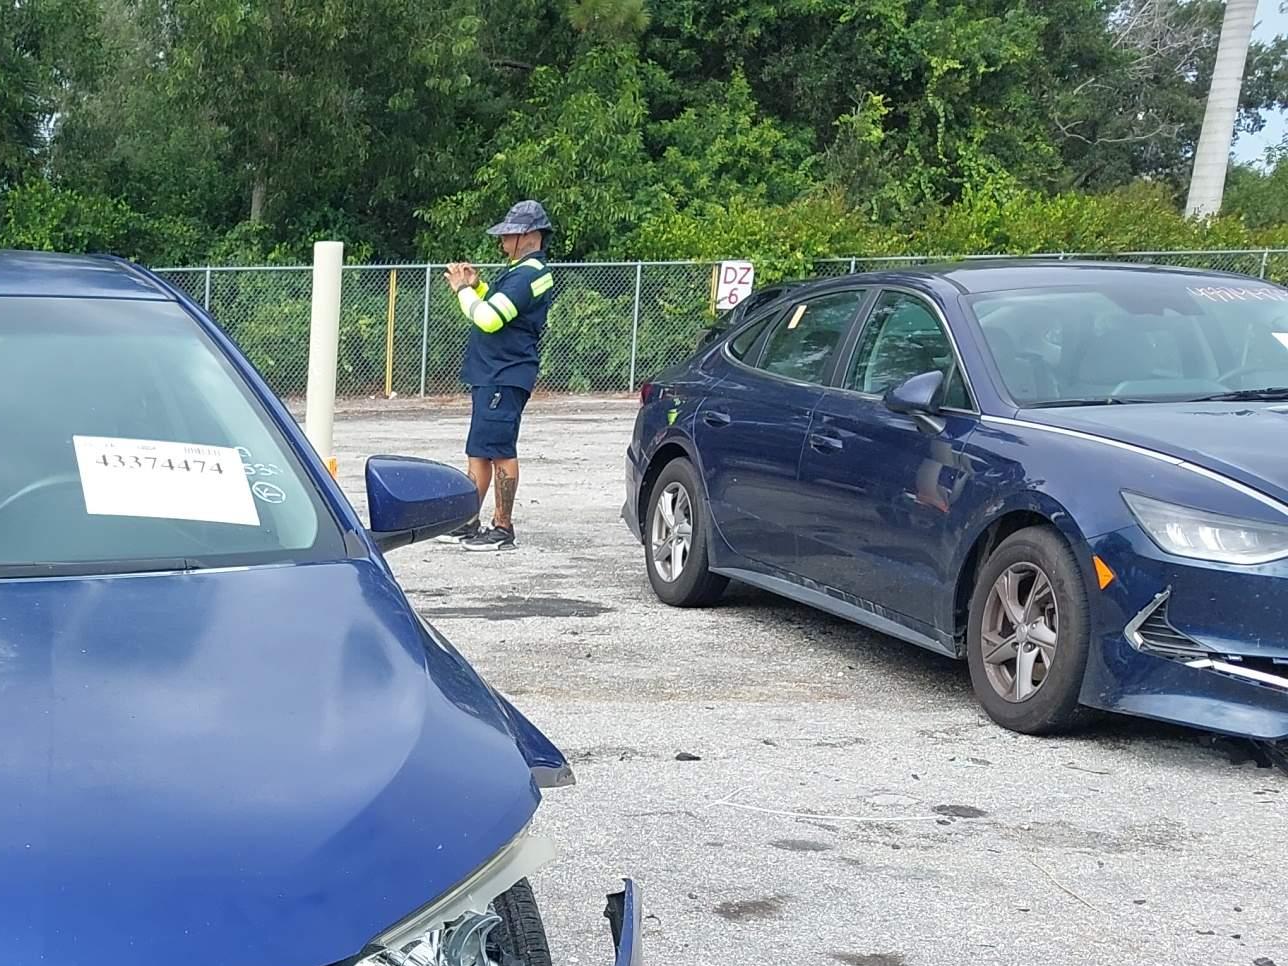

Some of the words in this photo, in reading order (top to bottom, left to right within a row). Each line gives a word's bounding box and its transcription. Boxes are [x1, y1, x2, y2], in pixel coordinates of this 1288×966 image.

[724, 266, 752, 285] DZ
[728, 287, 738, 305] 6
[95, 454, 224, 475] 43374474
